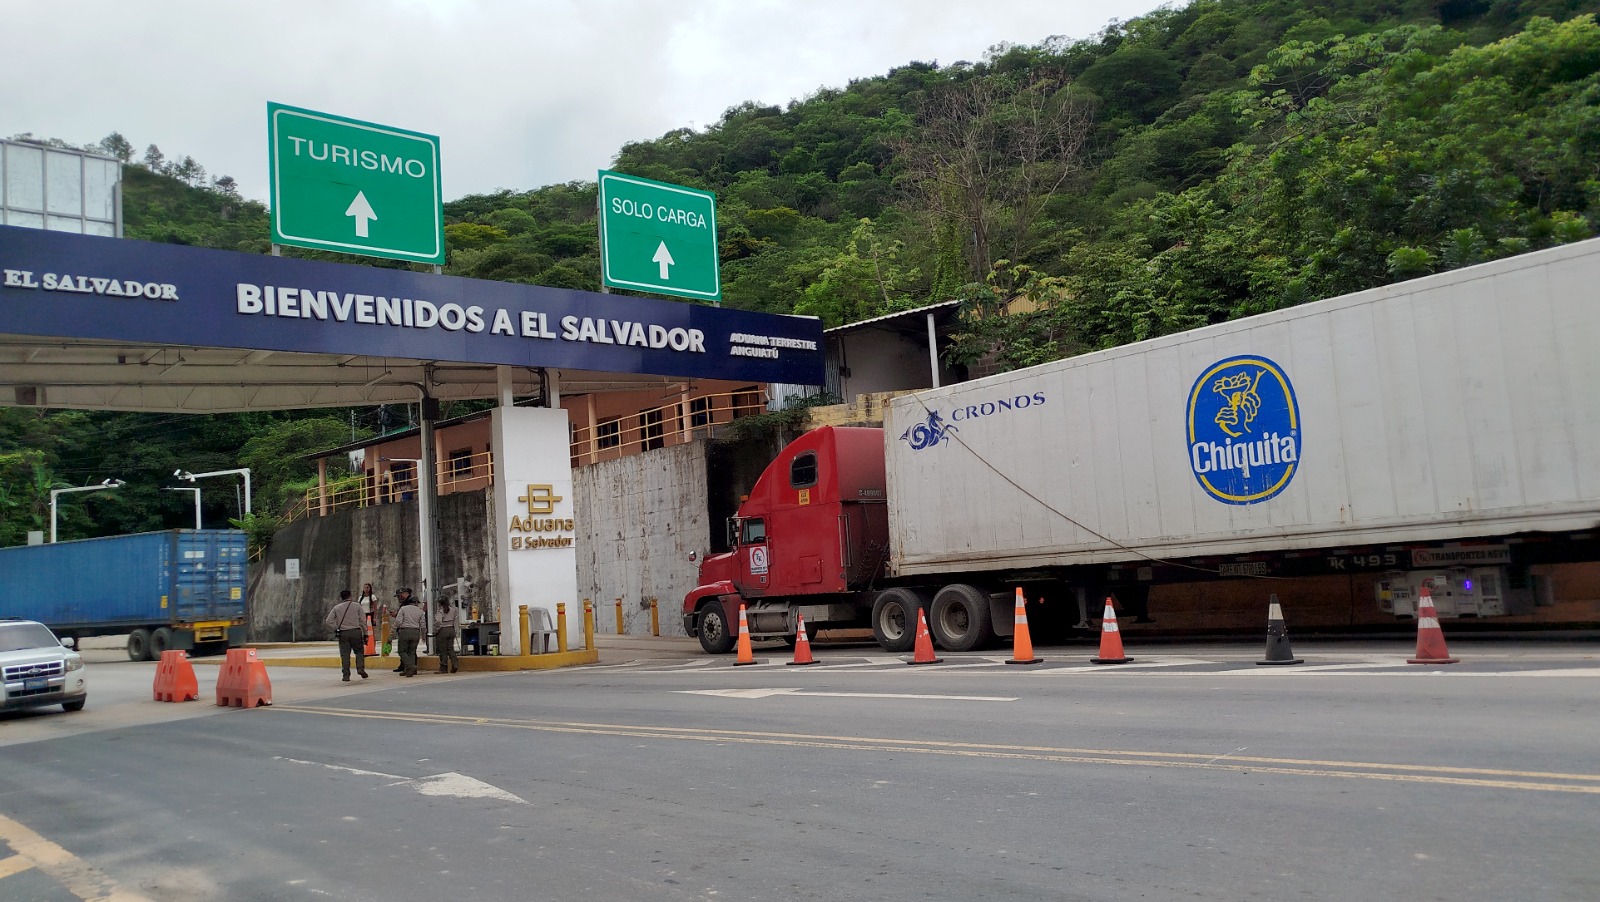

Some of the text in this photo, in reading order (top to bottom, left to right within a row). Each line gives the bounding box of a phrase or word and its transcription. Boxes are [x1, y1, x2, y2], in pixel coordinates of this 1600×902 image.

[287, 135, 426, 179] TURISMO
[612, 198, 707, 230] SOLO CARGA
[3, 269, 180, 301] EL SALVADOR
[236, 283, 706, 353] BIENVENIDOS A EL SALVADOR
[730, 332, 817, 351] ADUANA TERRESTRE
[730, 346, 779, 359] ANGUIATÚ
[951, 391, 1047, 422] CRONOS
[1192, 432, 1297, 478] Chiquita
[509, 515, 575, 532] Aduana
[511, 535, 573, 550] El Salvador
[1354, 554, 1397, 567] 493
[1431, 551, 1486, 562] TRANSPORTES
